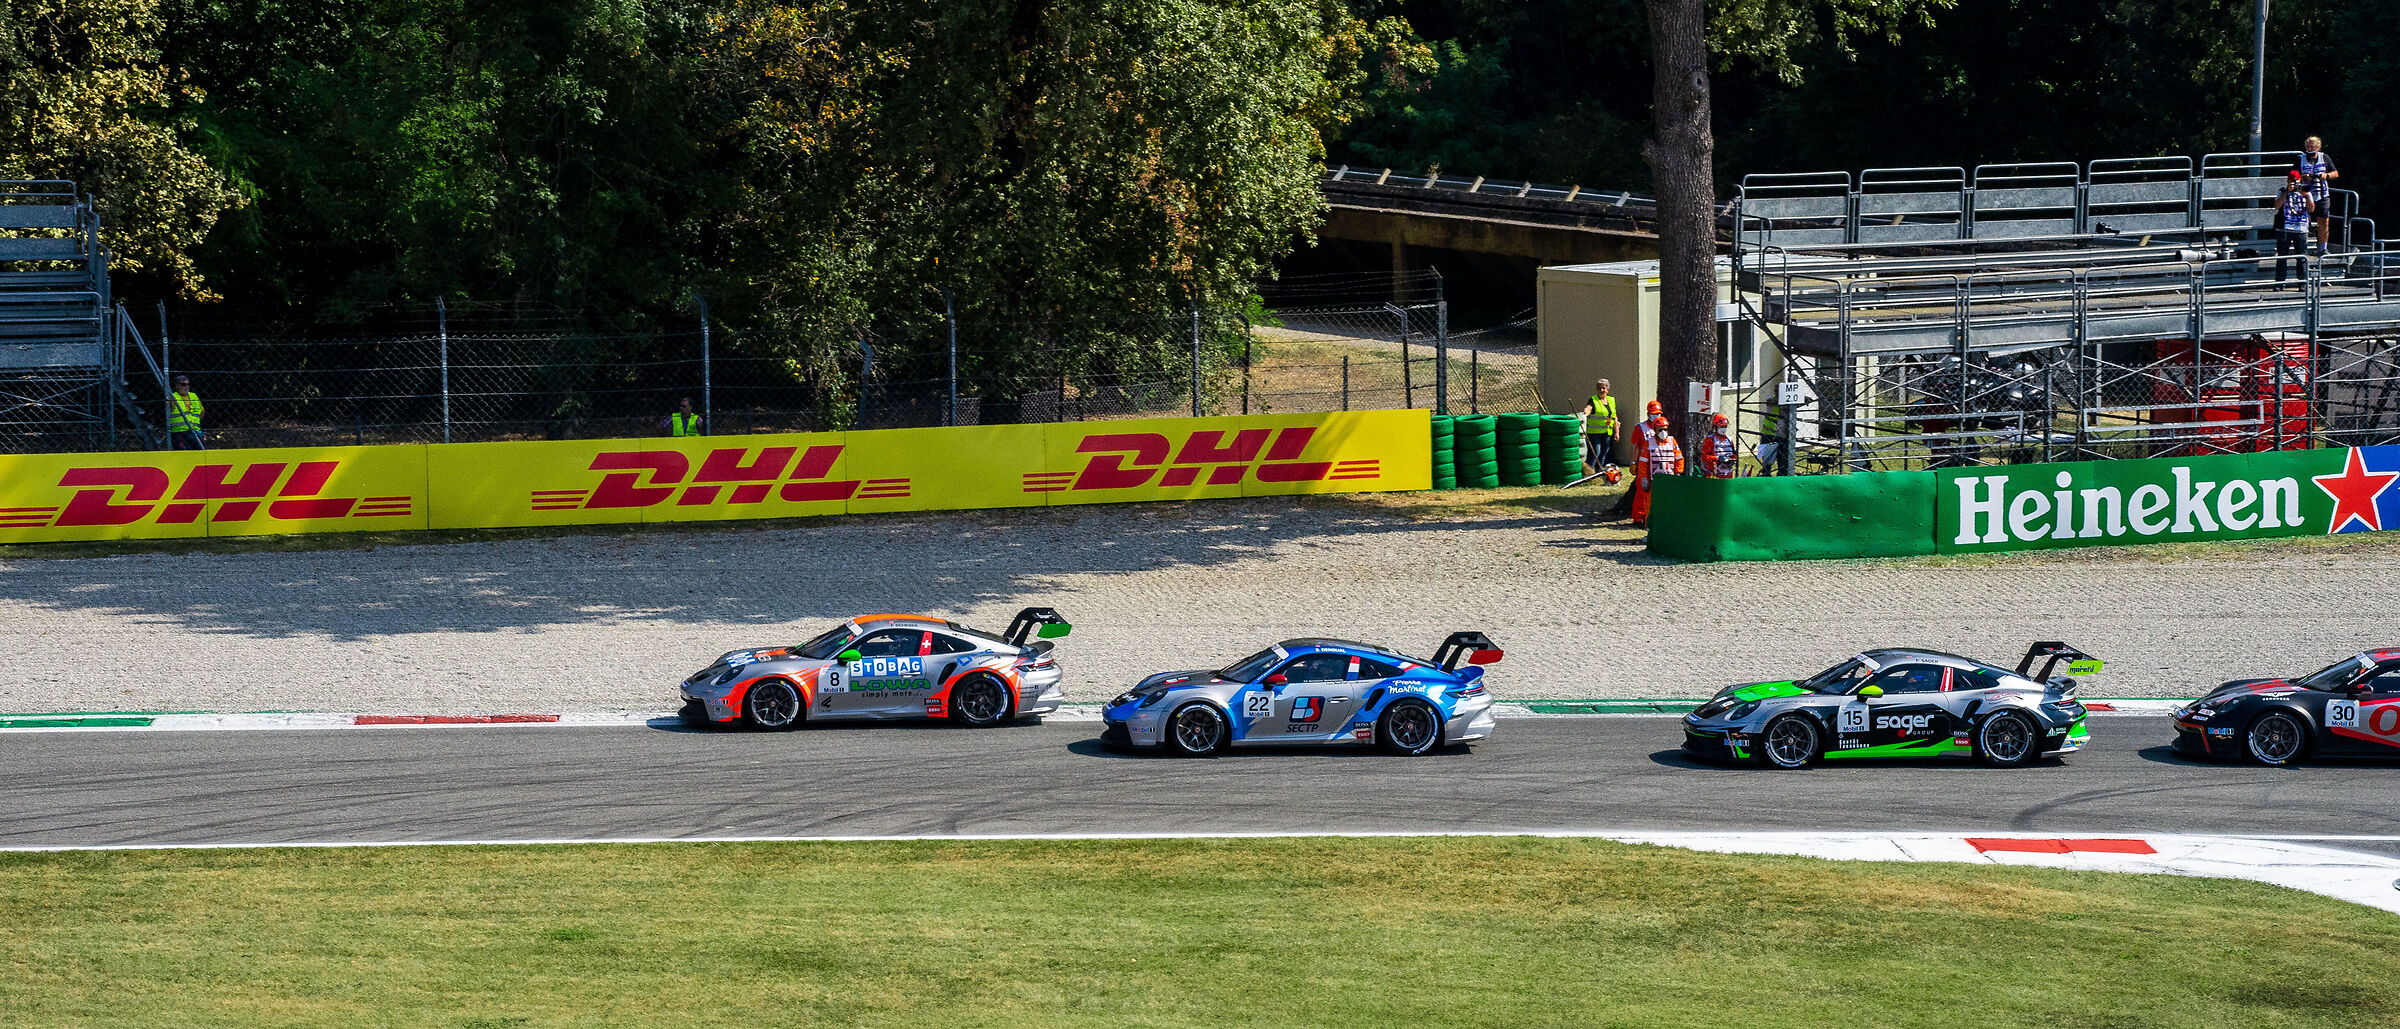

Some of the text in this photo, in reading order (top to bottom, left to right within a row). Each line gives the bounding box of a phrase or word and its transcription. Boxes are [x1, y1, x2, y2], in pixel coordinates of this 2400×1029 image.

[1785, 384, 1799, 392] MP
[1785, 394, 1799, 402] 2.0
[1071, 426, 1334, 490] DHL
[583, 444, 862, 509] DHL
[53, 461, 358, 526] DHL
[1954, 466, 2305, 545] Heineken
[853, 660, 921, 673] STOBAG
[829, 672, 840, 686] 8
[850, 679, 931, 691] LOWA
[861, 691, 889, 699] simply
[1387, 685, 1427, 694] Martinet
[1248, 696, 1269, 711] 22
[1843, 710, 1863, 726] 15
[2332, 705, 2355, 721] 30
[1286, 724, 1319, 733] SECTP
[1876, 714, 1935, 735] sager
